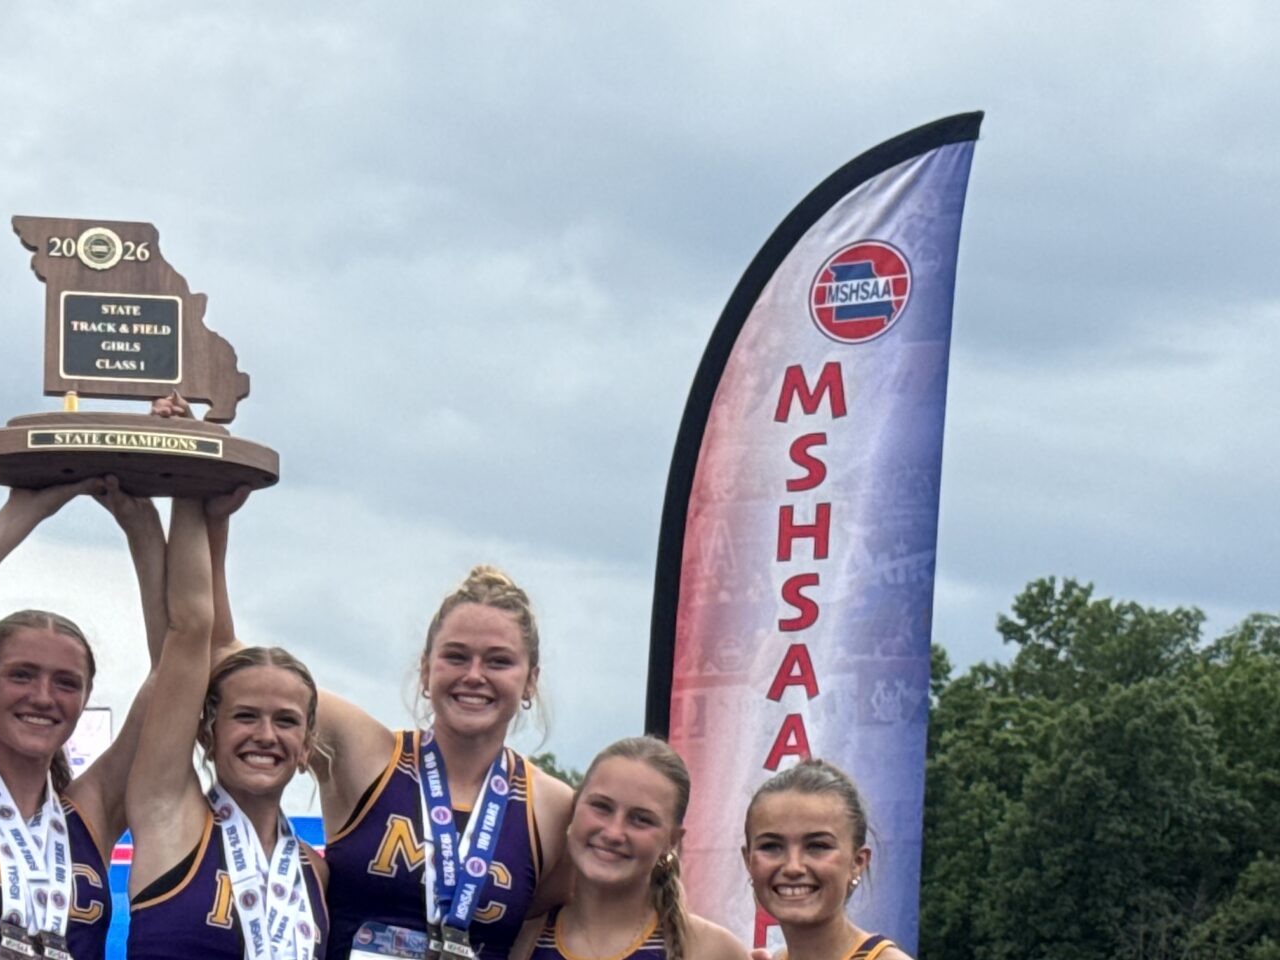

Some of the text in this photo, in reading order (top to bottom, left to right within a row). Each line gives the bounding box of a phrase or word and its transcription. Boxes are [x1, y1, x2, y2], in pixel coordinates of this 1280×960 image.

[48, 237, 150, 261] 20 26
[826, 279, 892, 305] MSHSAA
[101, 304, 141, 316] STATE
[71, 321, 172, 335] TRACK & FIELD
[101, 340, 141, 352] GIRLS
[95, 358, 137, 371] CLASS
[53, 432, 198, 450] STATE CHAMPIONS
[764, 362, 847, 770] MSHSAA
[477, 802, 500, 851] 100 YEARS
[368, 813, 513, 924] MC
